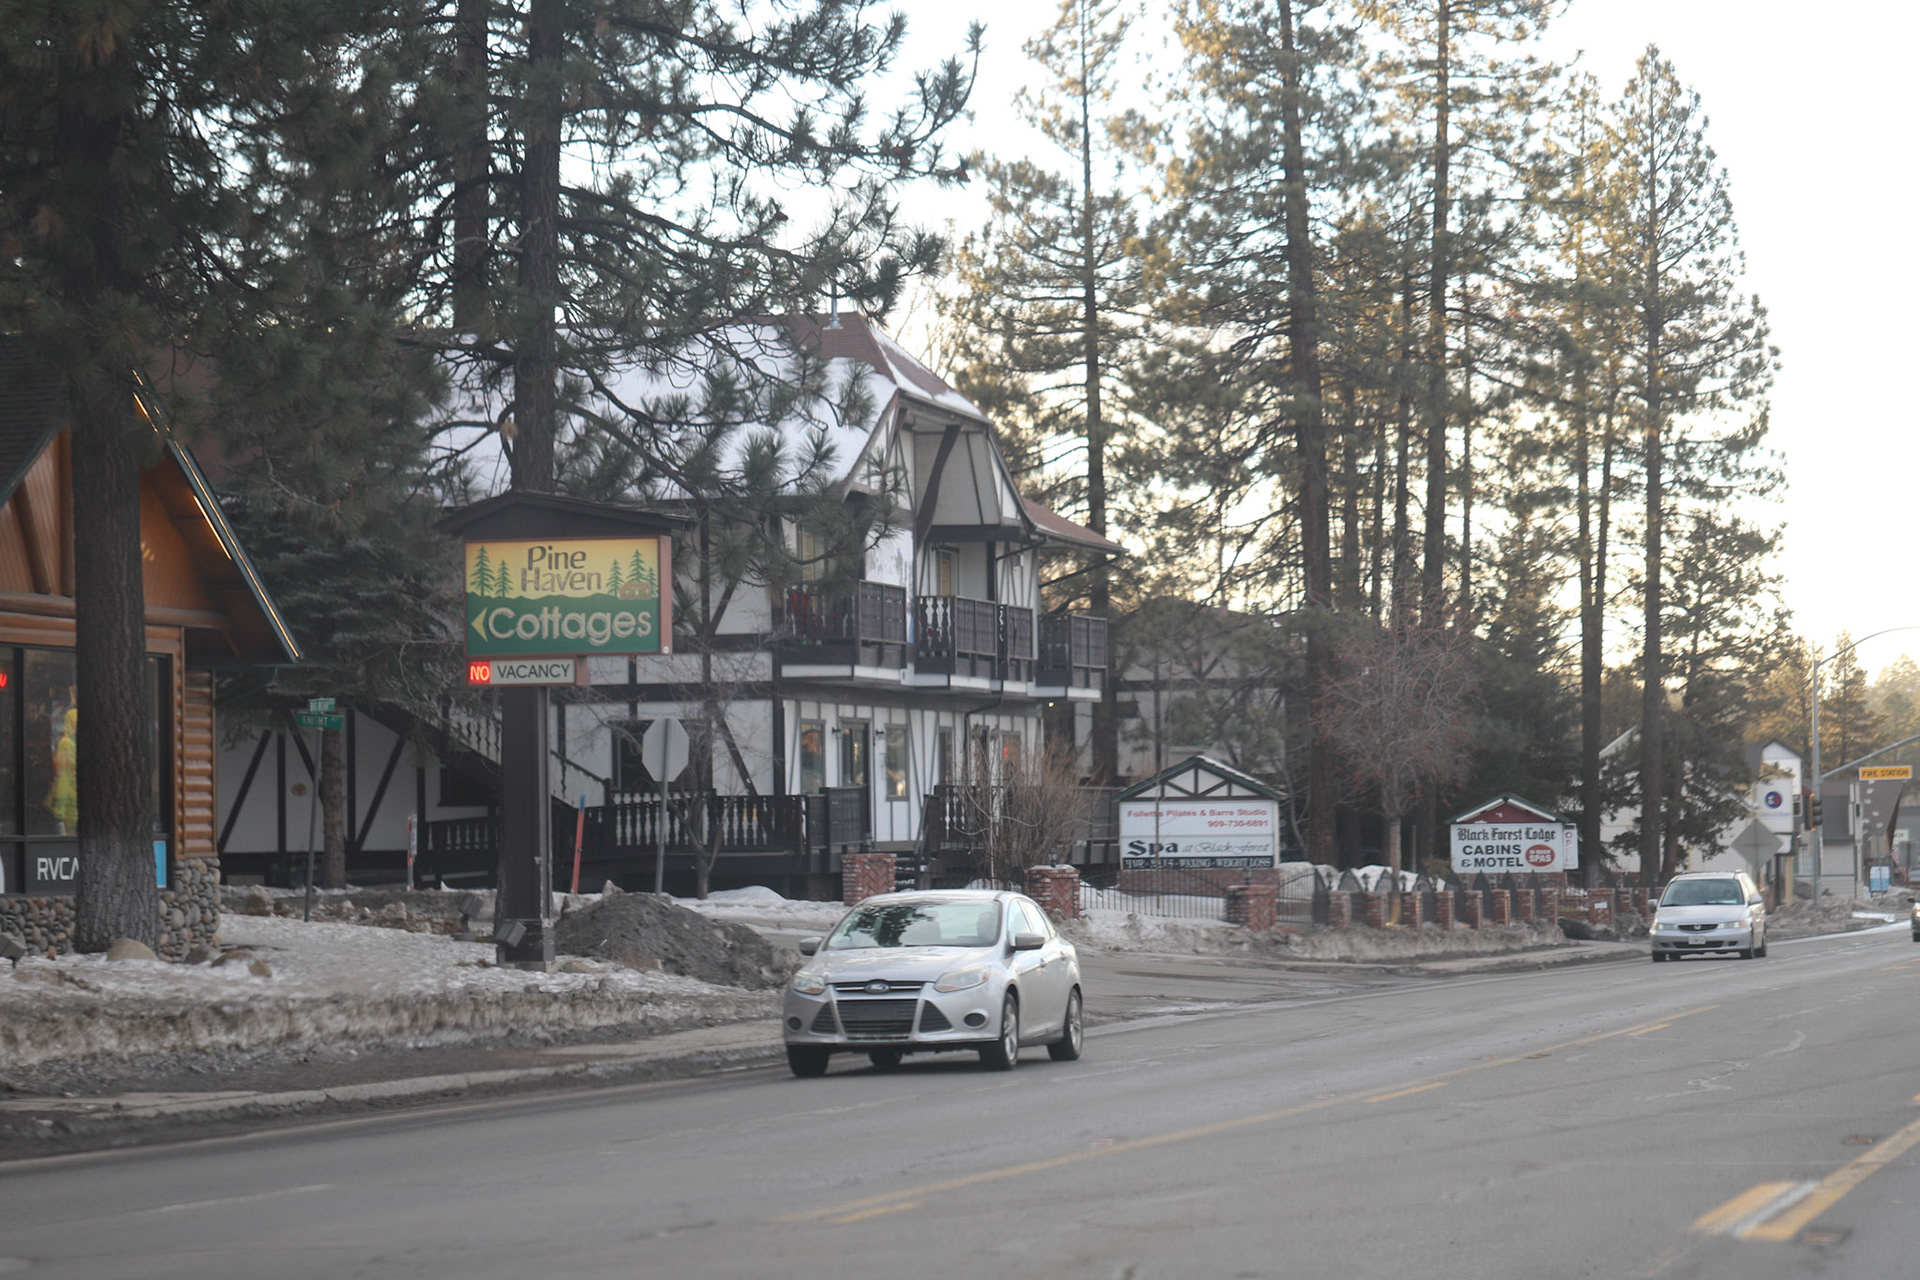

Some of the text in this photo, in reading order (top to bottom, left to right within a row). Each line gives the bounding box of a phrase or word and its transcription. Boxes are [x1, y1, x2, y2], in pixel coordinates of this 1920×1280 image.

[527, 545, 587, 570] Pine
[520, 567, 602, 593] Haven
[488, 606, 652, 647] Cottages
[469, 663, 570, 681] NO VACANCY
[1880, 768, 1909, 777] STATION
[1237, 808, 1267, 816] Studio
[1457, 827, 1556, 842] Black Forest Lodge
[1127, 840, 1178, 856] Spa
[1463, 844, 1521, 855] CABINS
[1461, 857, 1524, 868] & MOTEL
[1529, 854, 1552, 863] SPAS
